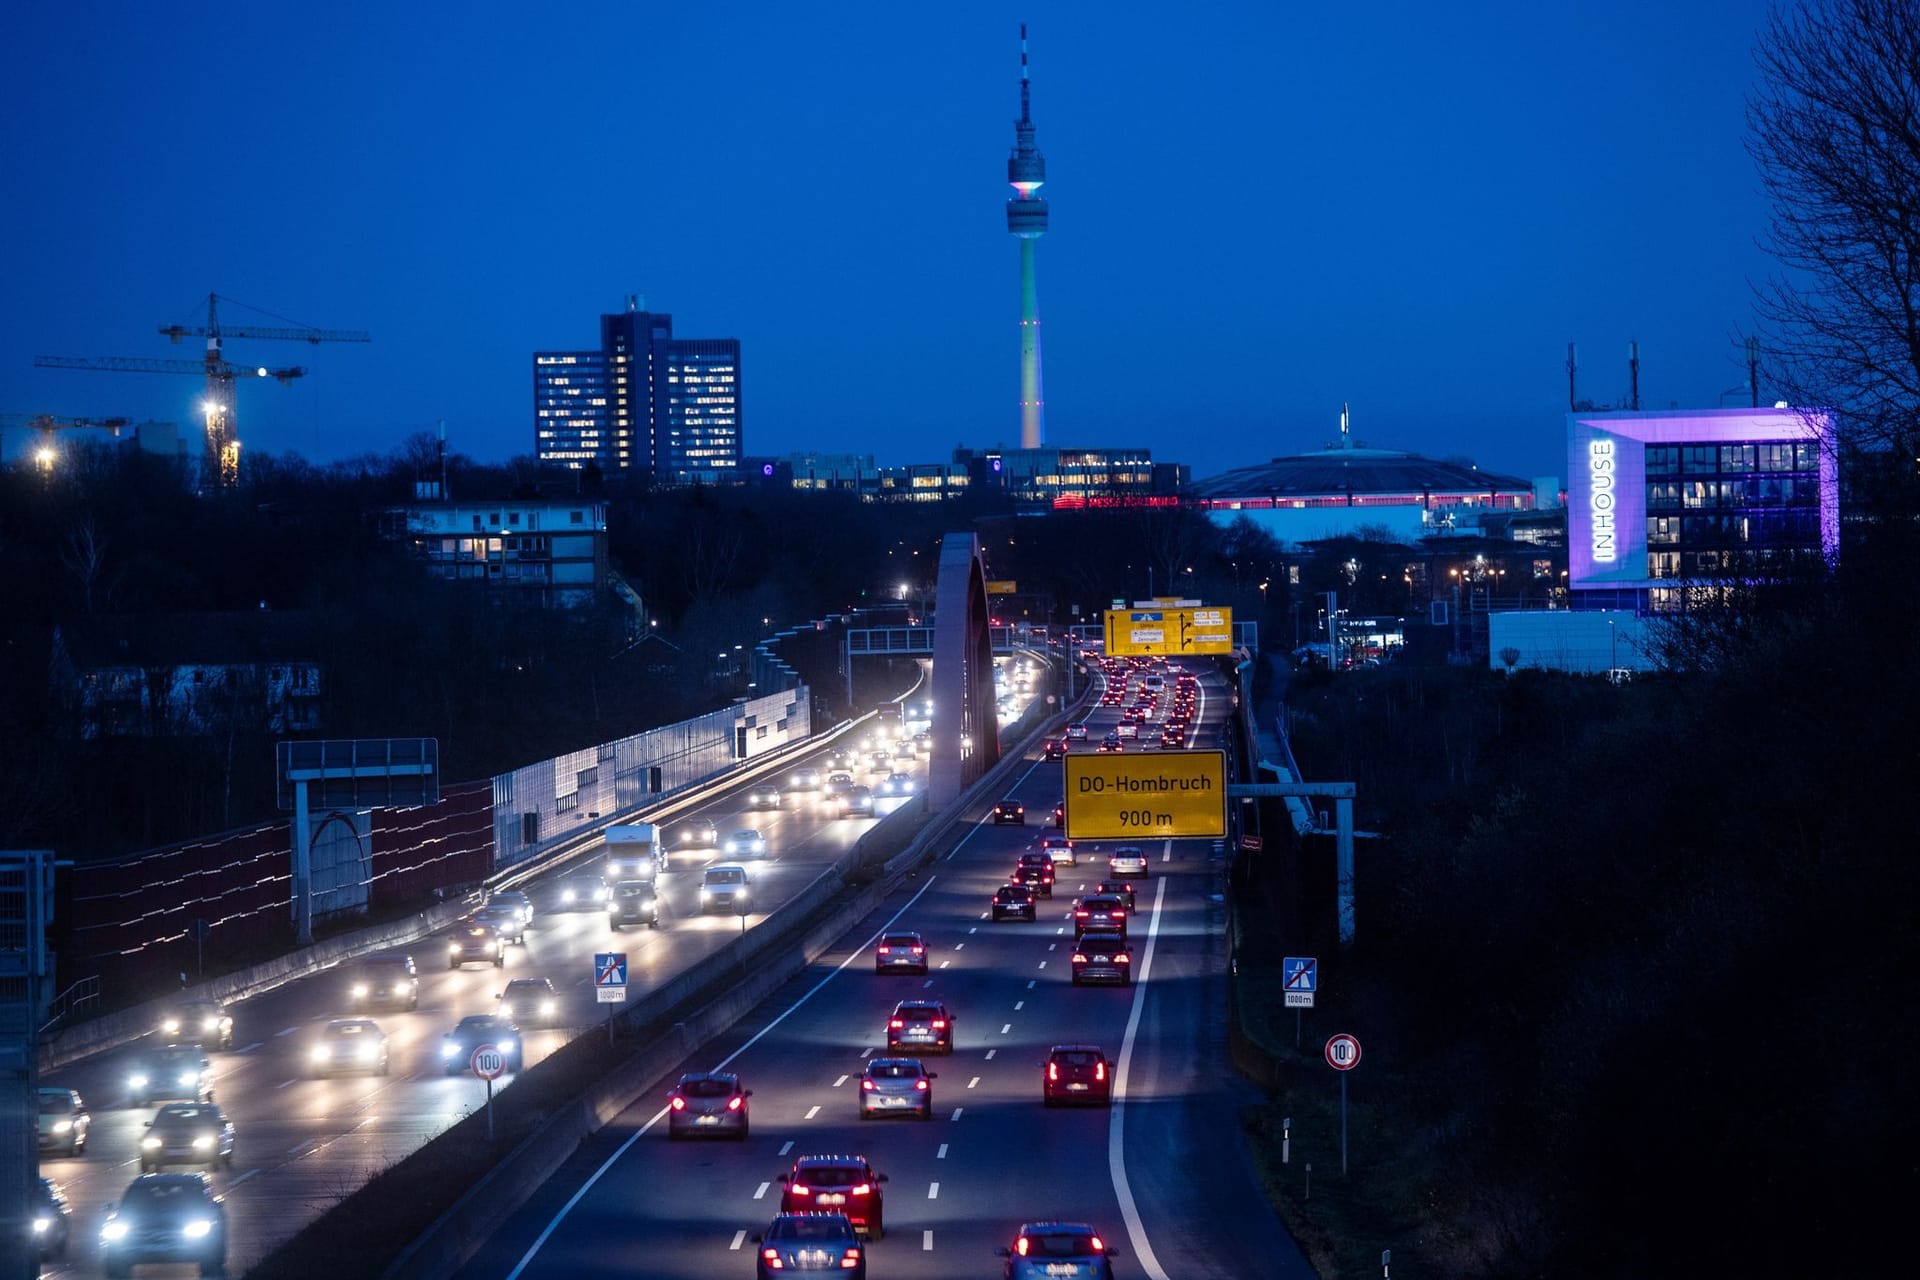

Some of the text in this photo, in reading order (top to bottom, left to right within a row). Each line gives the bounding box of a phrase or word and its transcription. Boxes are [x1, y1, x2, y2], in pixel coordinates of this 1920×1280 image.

[1591, 440, 1614, 561] INHOUSE
[1080, 774, 1211, 793] DO-Hombruch
[1119, 810, 1173, 827] 900 m
[1333, 1044, 1354, 1060] 100
[478, 1054, 500, 1071] 100
